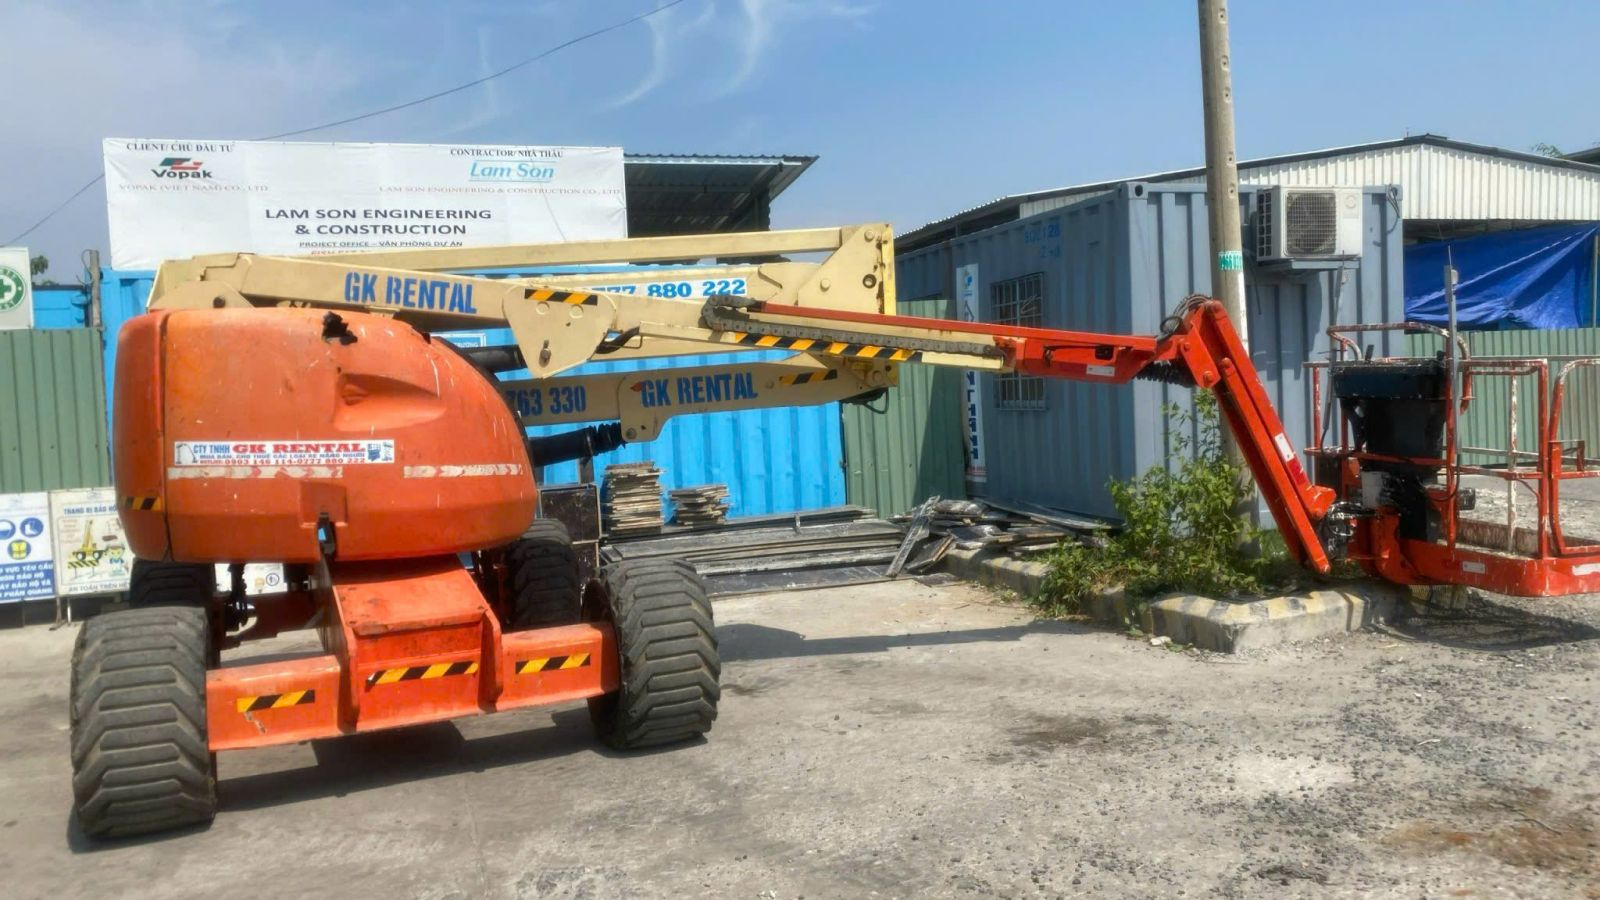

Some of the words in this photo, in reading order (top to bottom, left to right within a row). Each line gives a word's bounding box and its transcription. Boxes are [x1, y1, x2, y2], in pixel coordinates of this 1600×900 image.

[126, 142, 168, 152] CLIENT/
[151, 169, 213, 180] Vopak
[469, 161, 512, 178] Lam
[517, 163, 555, 179] Son
[265, 209, 310, 219] LAM
[315, 209, 357, 219] SON
[363, 209, 492, 219] ENGINEERING
[295, 224, 311, 235] &
[316, 224, 467, 235] CONSTRUCTION
[344, 272, 378, 304] GK
[386, 276, 477, 314] RENTAL
[647, 283, 692, 298] 880
[702, 279, 746, 296] 222
[642, 377, 672, 407] GK
[677, 372, 758, 404] RENTAL
[549, 385, 587, 414] 330
[193, 445, 207, 453] CTY
[209, 444, 231, 453] TNHH
[232, 444, 267, 453] GK
[272, 443, 366, 453] RENTAL
